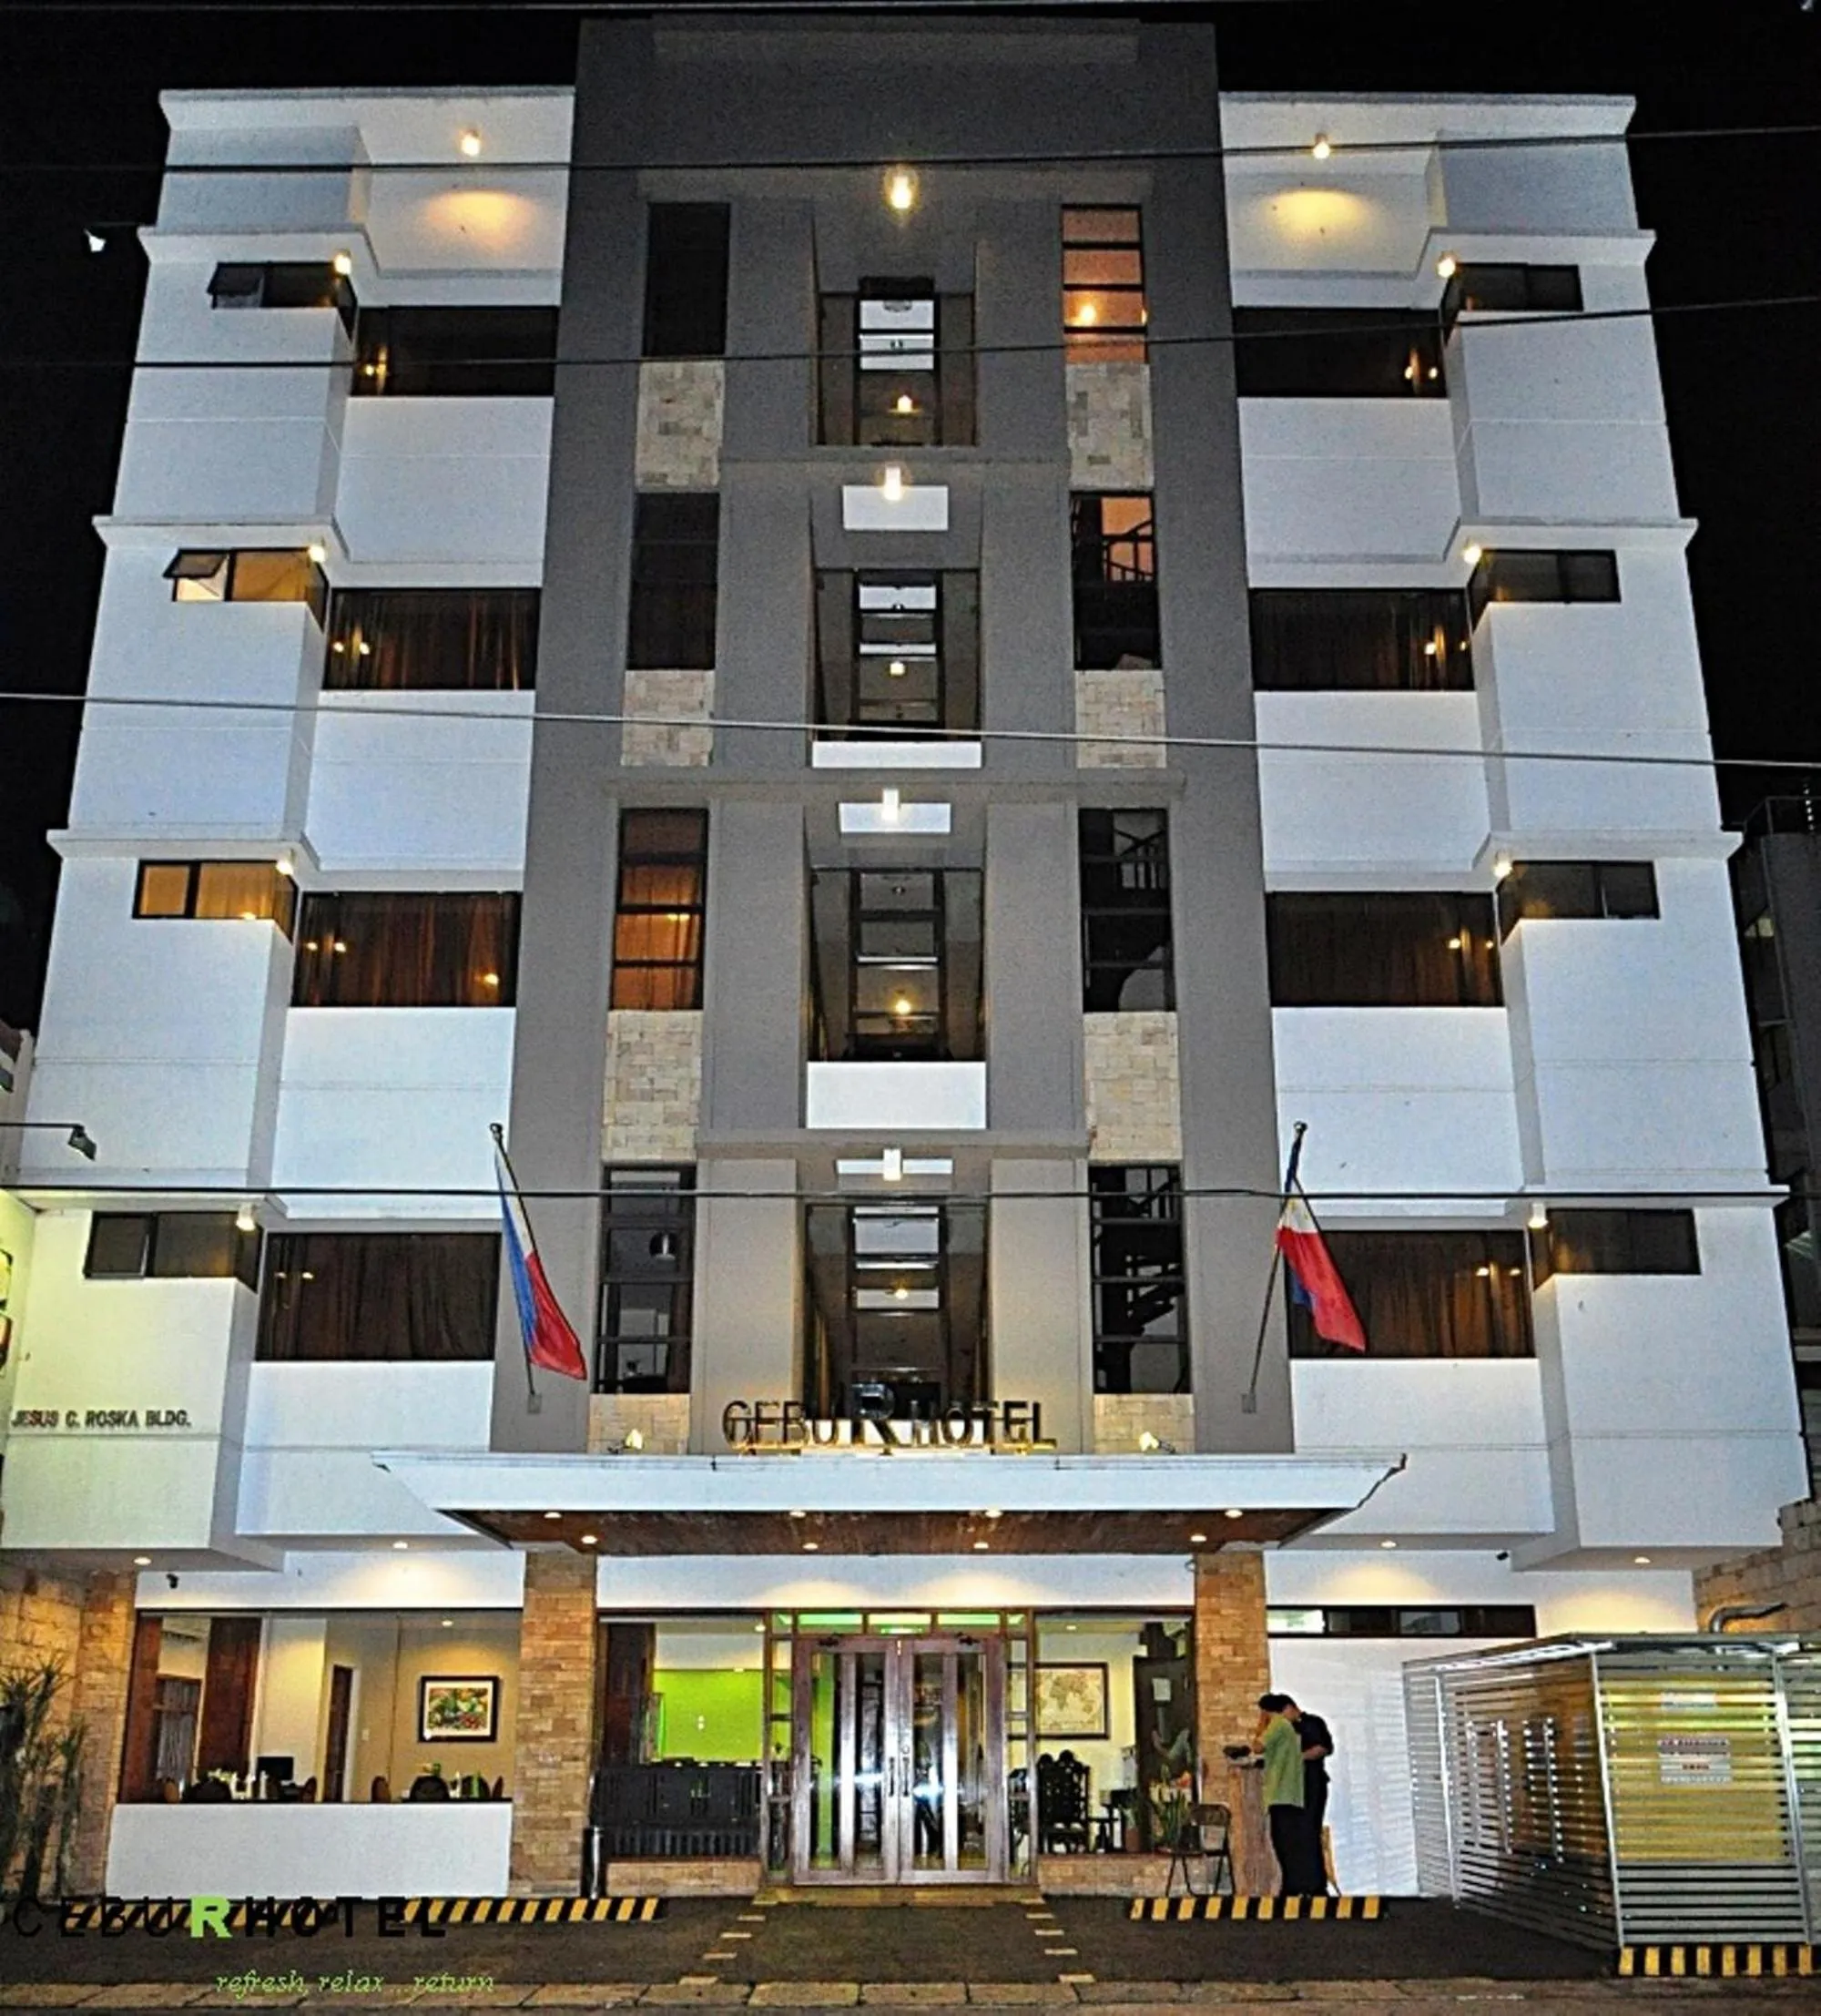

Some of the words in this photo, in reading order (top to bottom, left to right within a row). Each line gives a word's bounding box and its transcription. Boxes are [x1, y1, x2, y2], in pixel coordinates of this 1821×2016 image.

[11, 1410, 60, 1428] JESUS
[65, 1410, 80, 1428] C.
[85, 1410, 140, 1428] ROSKA
[145, 1410, 192, 1428] BLDG.
[722, 1400, 840, 1448] CEBU
[850, 1380, 901, 1448] R
[910, 1400, 1057, 1448] HOTEL
